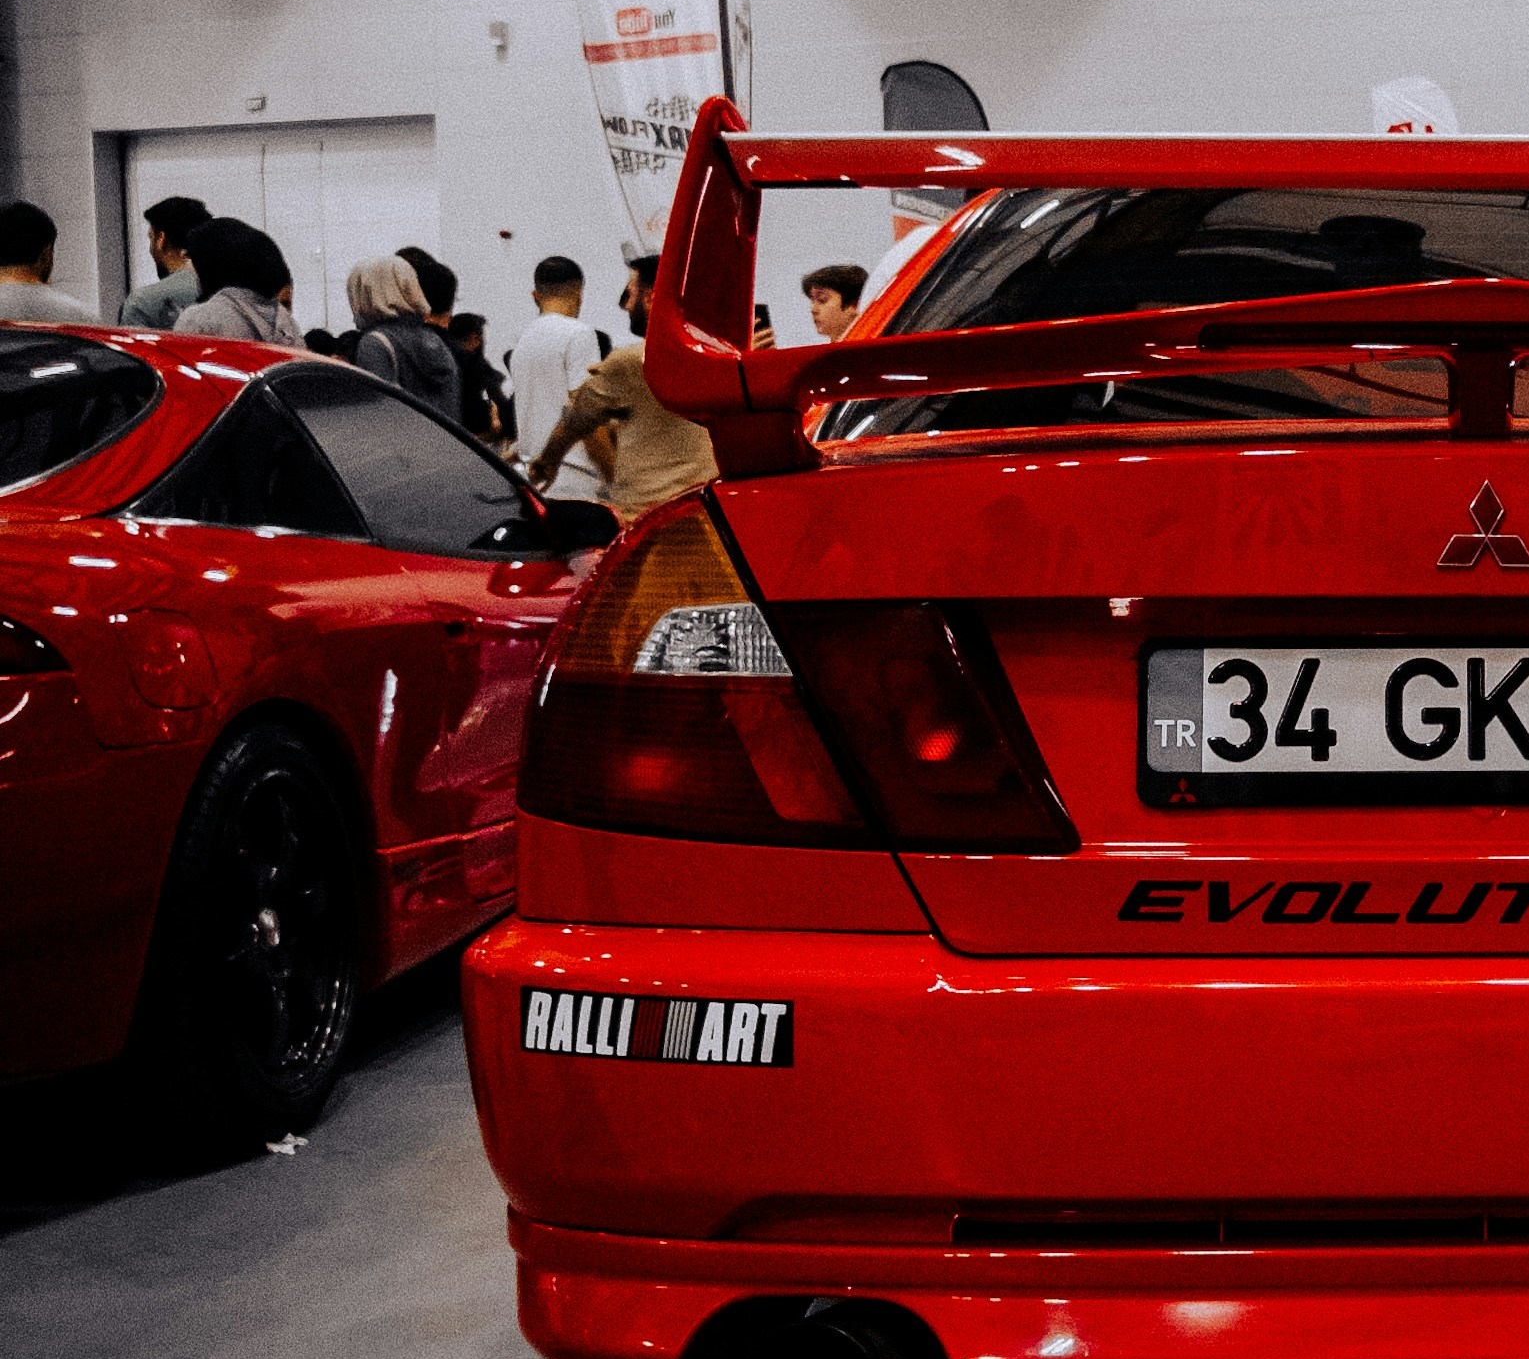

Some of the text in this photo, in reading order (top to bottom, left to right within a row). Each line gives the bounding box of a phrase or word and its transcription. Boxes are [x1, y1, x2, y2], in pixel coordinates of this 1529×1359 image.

[1154, 719, 1197, 748] TR
[1207, 657, 1337, 763] 34
[525, 991, 787, 1064] RALLI ART
